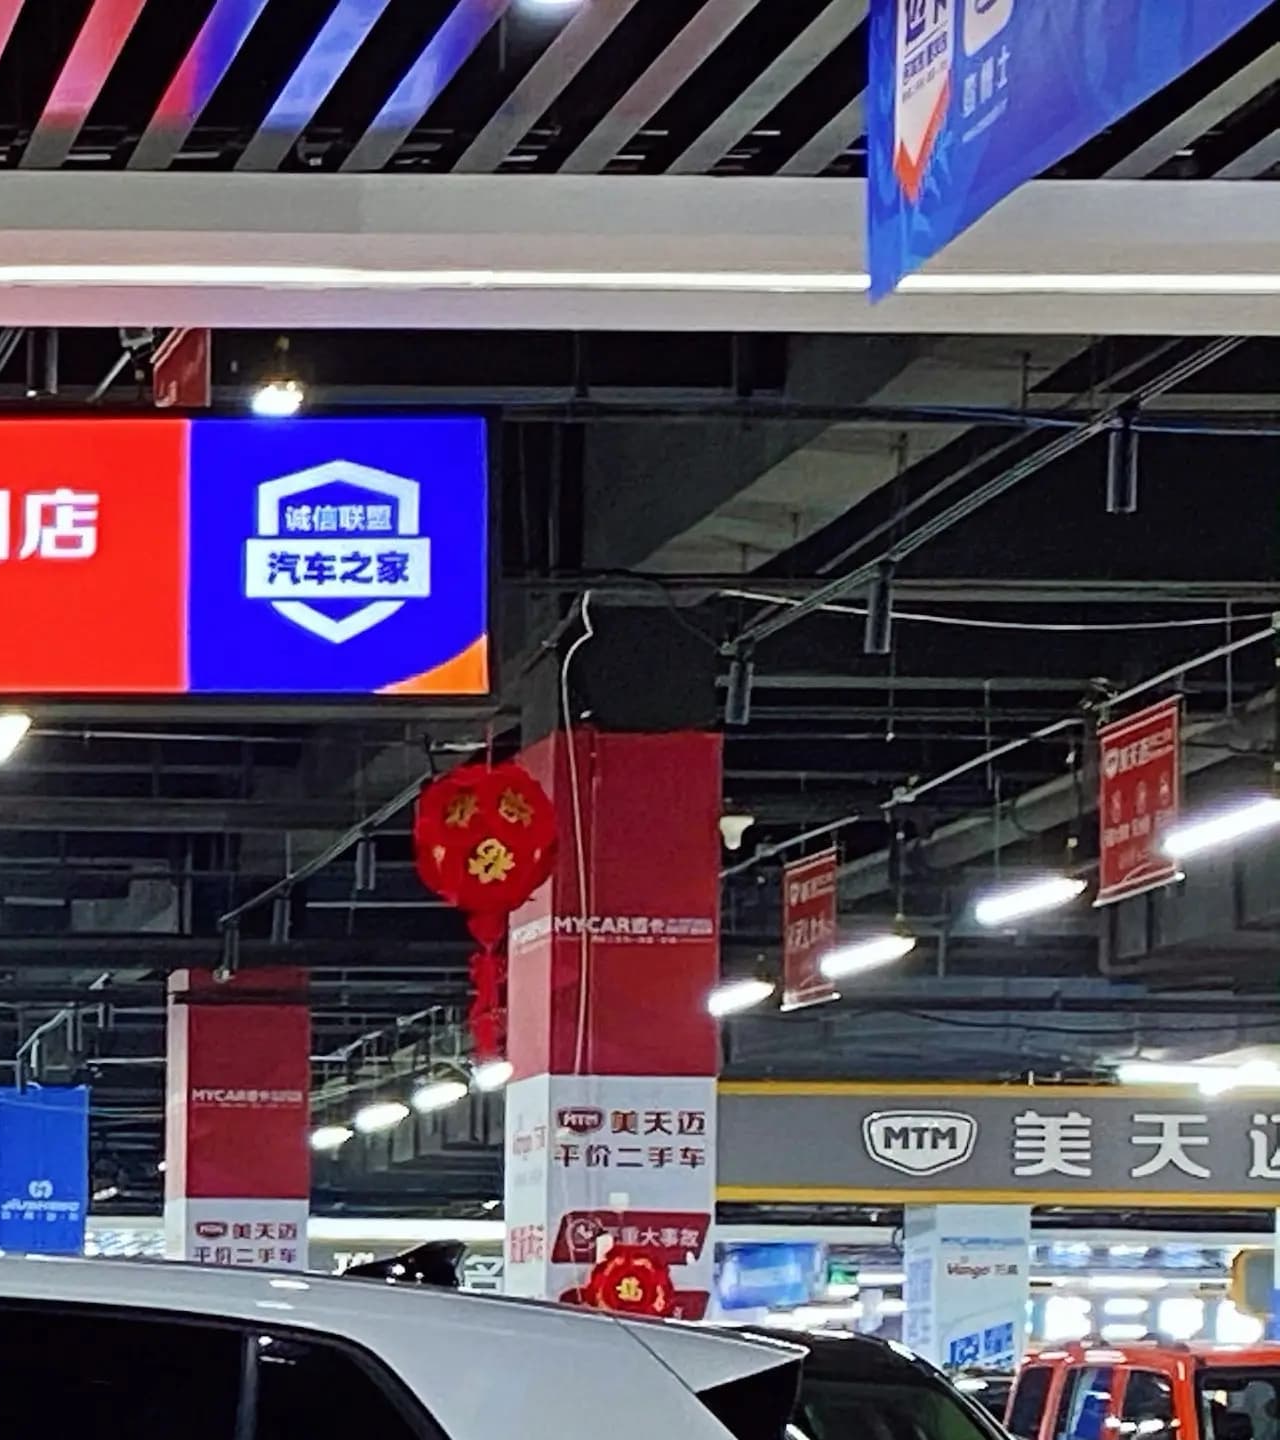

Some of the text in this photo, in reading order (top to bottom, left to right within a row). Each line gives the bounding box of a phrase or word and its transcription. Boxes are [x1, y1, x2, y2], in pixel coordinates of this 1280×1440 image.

[285, 503, 393, 535] 诚信联盟
[266, 551, 410, 587] 汽车之家
[610, 1110, 706, 1136] 美天迈
[883, 1124, 959, 1152] MTM
[554, 1143, 706, 1169] 平价二手车
[232, 1221, 297, 1240] 美天迈
